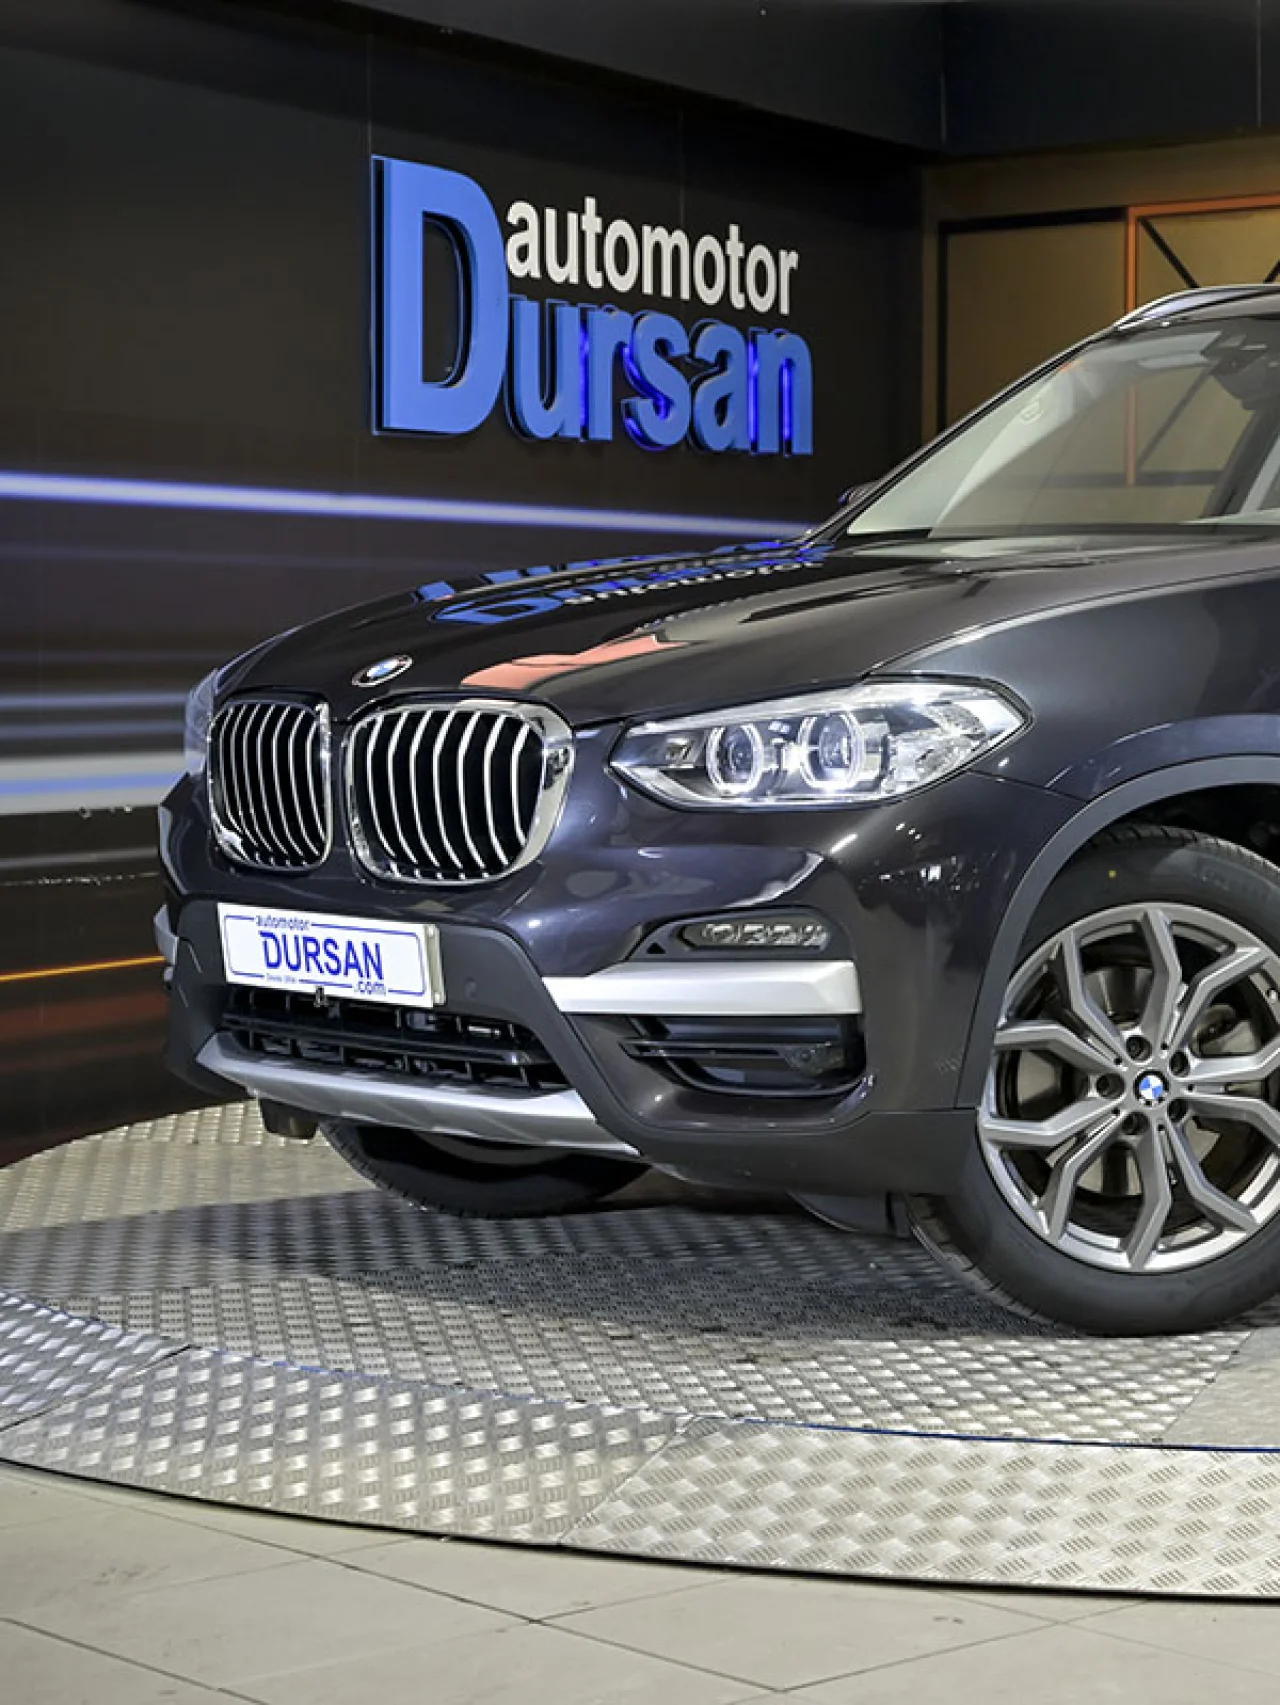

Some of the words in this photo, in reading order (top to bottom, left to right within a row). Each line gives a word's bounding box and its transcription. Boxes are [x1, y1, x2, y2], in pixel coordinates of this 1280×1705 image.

[506, 196, 798, 315] automotor
[371, 155, 813, 456] Dursan
[255, 915, 310, 930] automotor
[258, 930, 384, 980] DURSAN
[353, 981, 387, 996] .com
